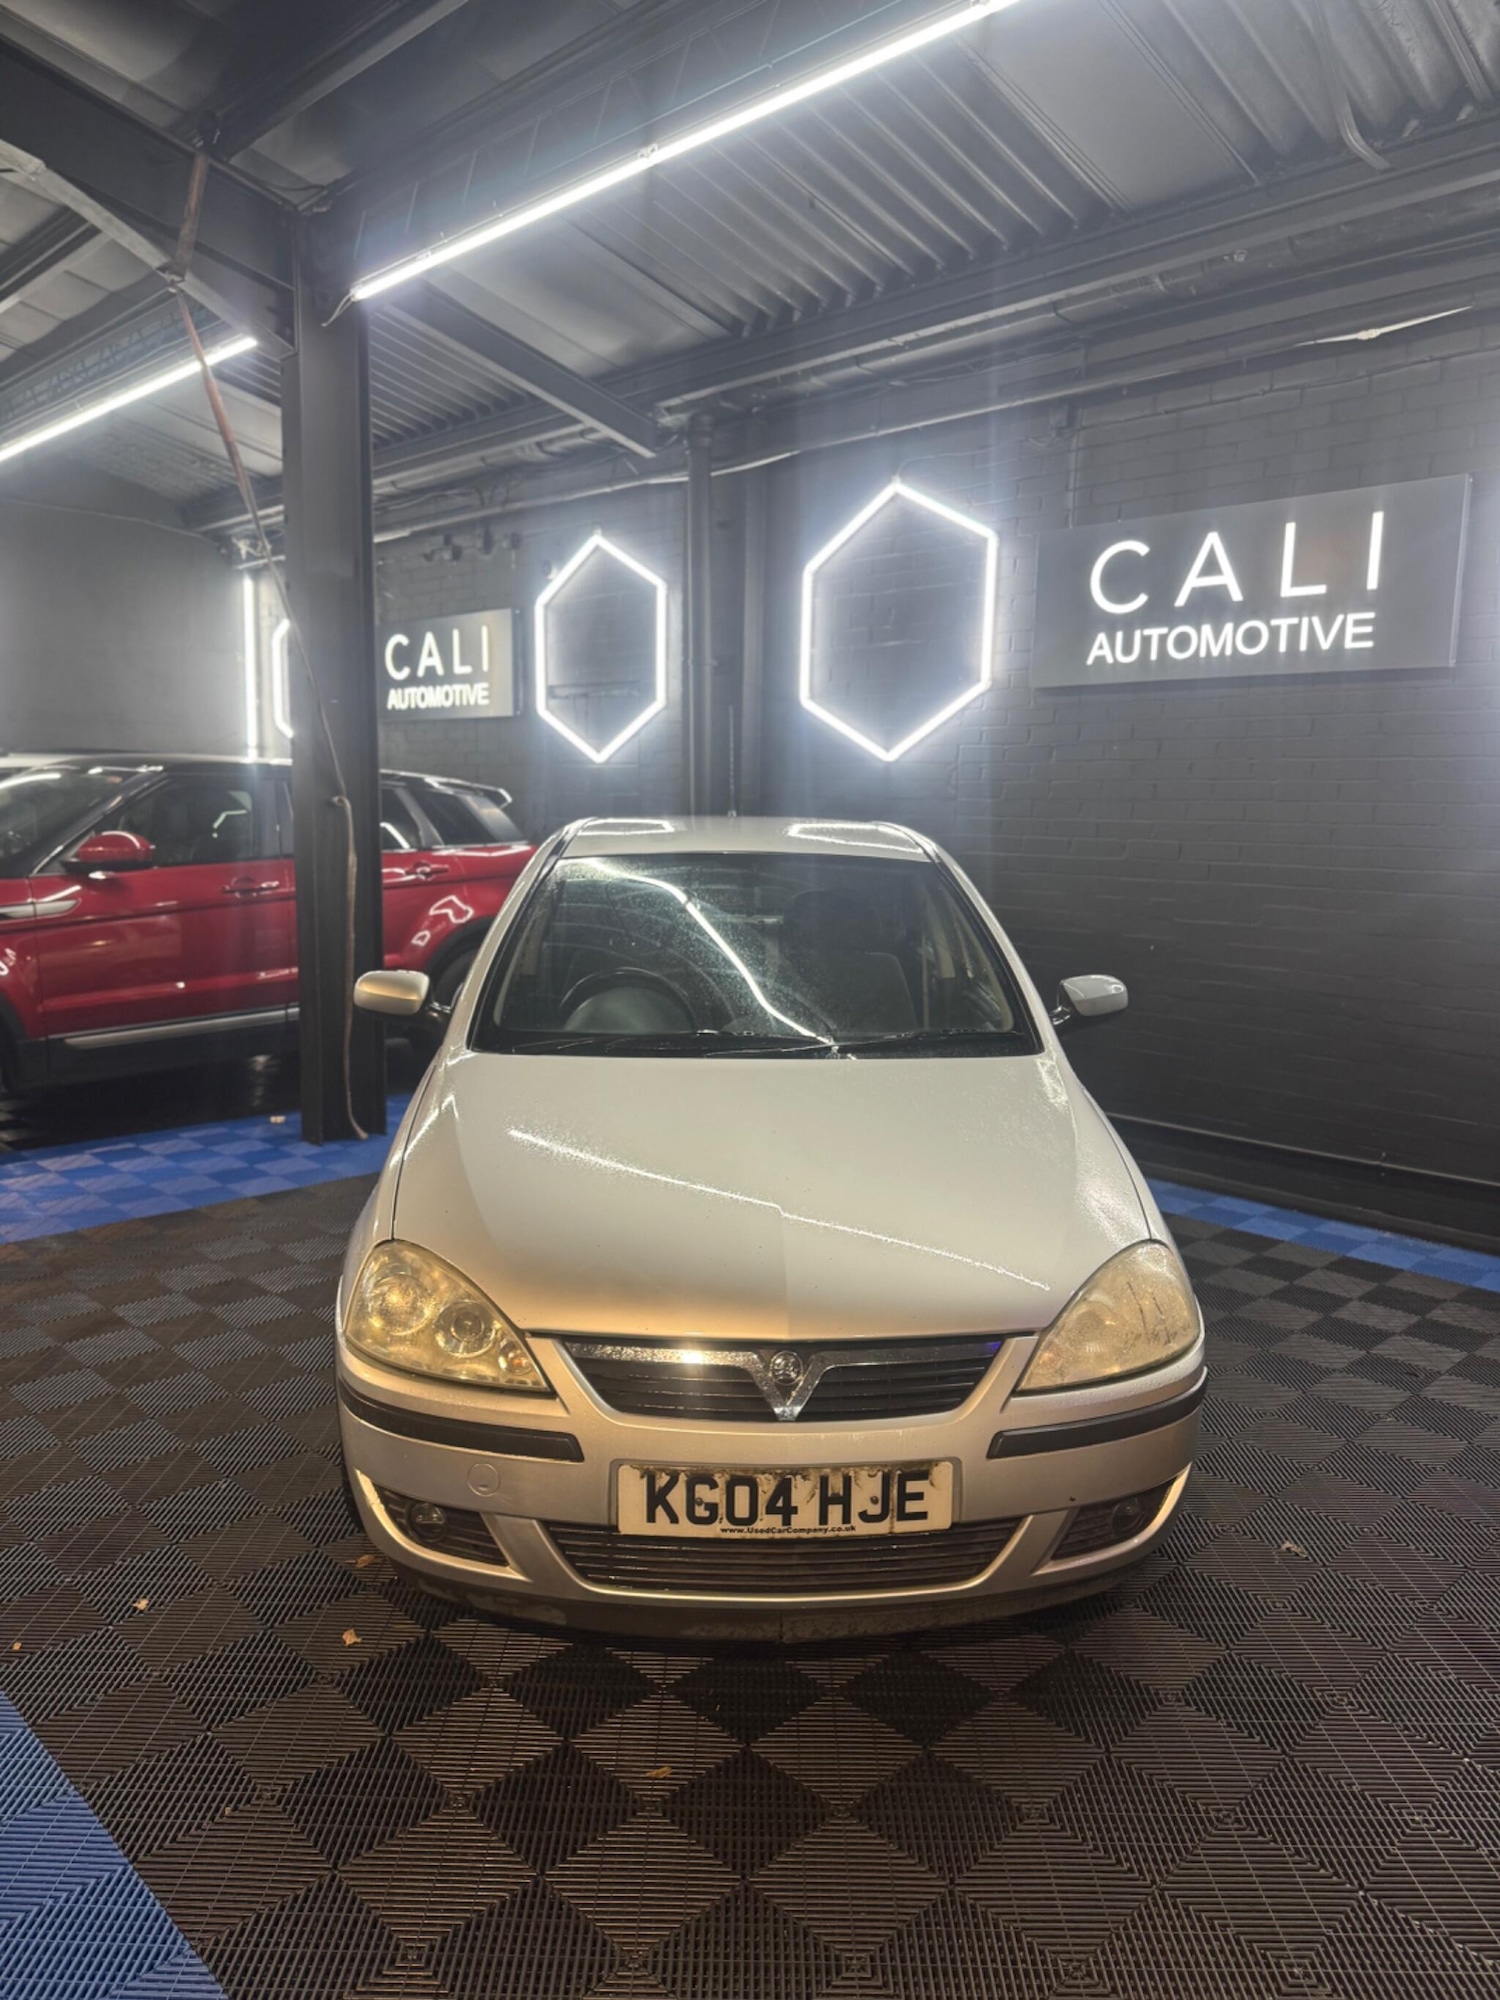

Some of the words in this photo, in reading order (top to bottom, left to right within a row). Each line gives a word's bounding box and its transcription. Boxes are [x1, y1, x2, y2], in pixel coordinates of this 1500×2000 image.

[1090, 511, 1384, 614] CALI
[384, 625, 489, 680] CALI
[1086, 612, 1376, 665] AUTOMOTIVE
[386, 683, 489, 710] AUTOMOTIVE
[645, 1471, 798, 1526] KG04
[817, 1468, 930, 1525] HJE
[720, 1525, 856, 1535] www.UsedCarCompany.co.uk
